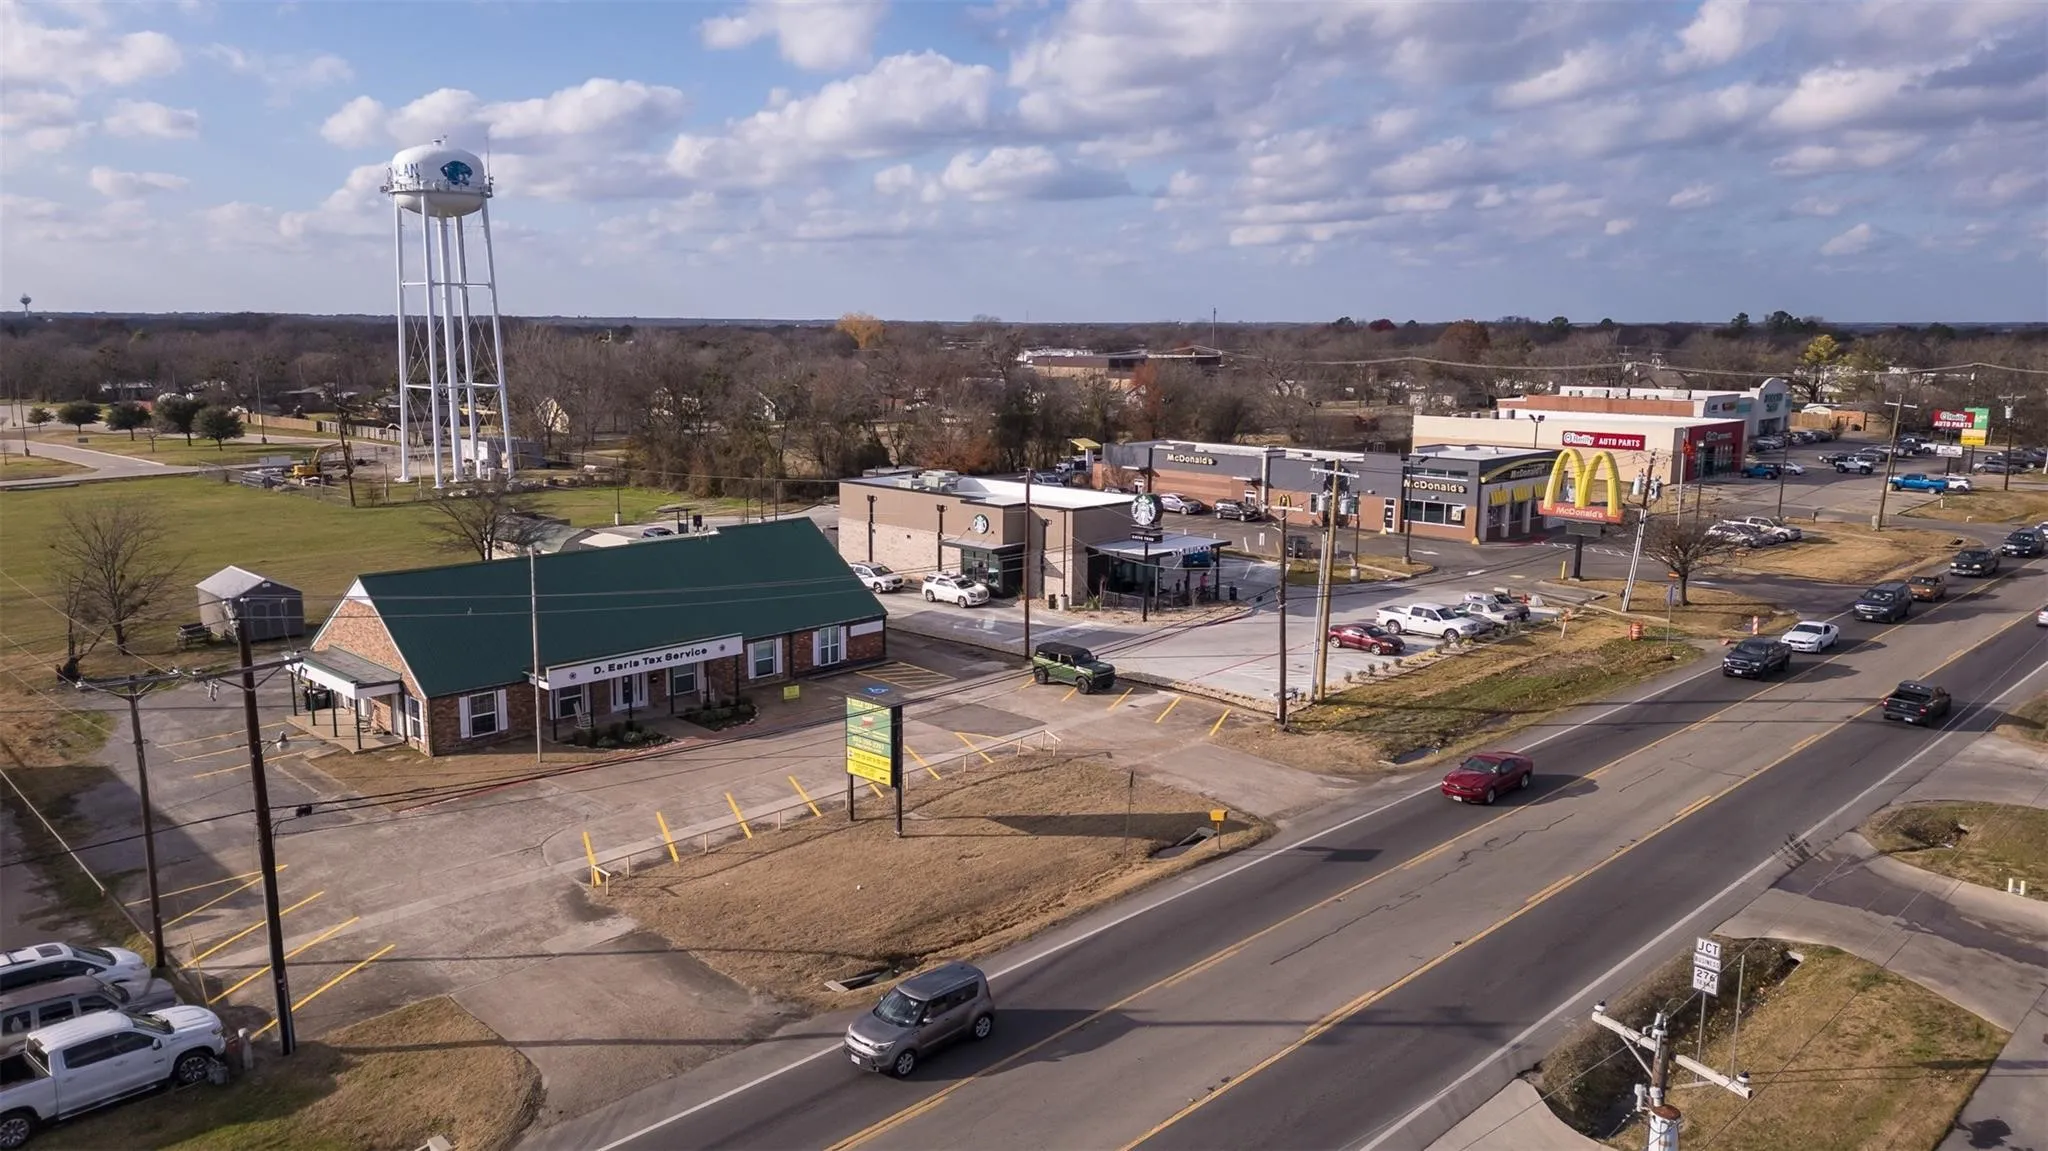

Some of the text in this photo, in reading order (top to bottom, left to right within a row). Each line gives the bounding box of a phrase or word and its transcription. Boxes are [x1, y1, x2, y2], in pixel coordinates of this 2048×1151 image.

[1598, 438, 1617, 446] AUTO
[1618, 438, 1640, 448] PARTS
[1167, 454, 1214, 465] McDonald's
[1404, 478, 1465, 494] McDonald's
[1556, 506, 1603, 518] McDonald's
[594, 648, 708, 674] D. Earle Tax Service
[1698, 941, 1718, 955] JCT
[1694, 956, 1720, 968] BUSINESS
[1696, 970, 1716, 982] 276
